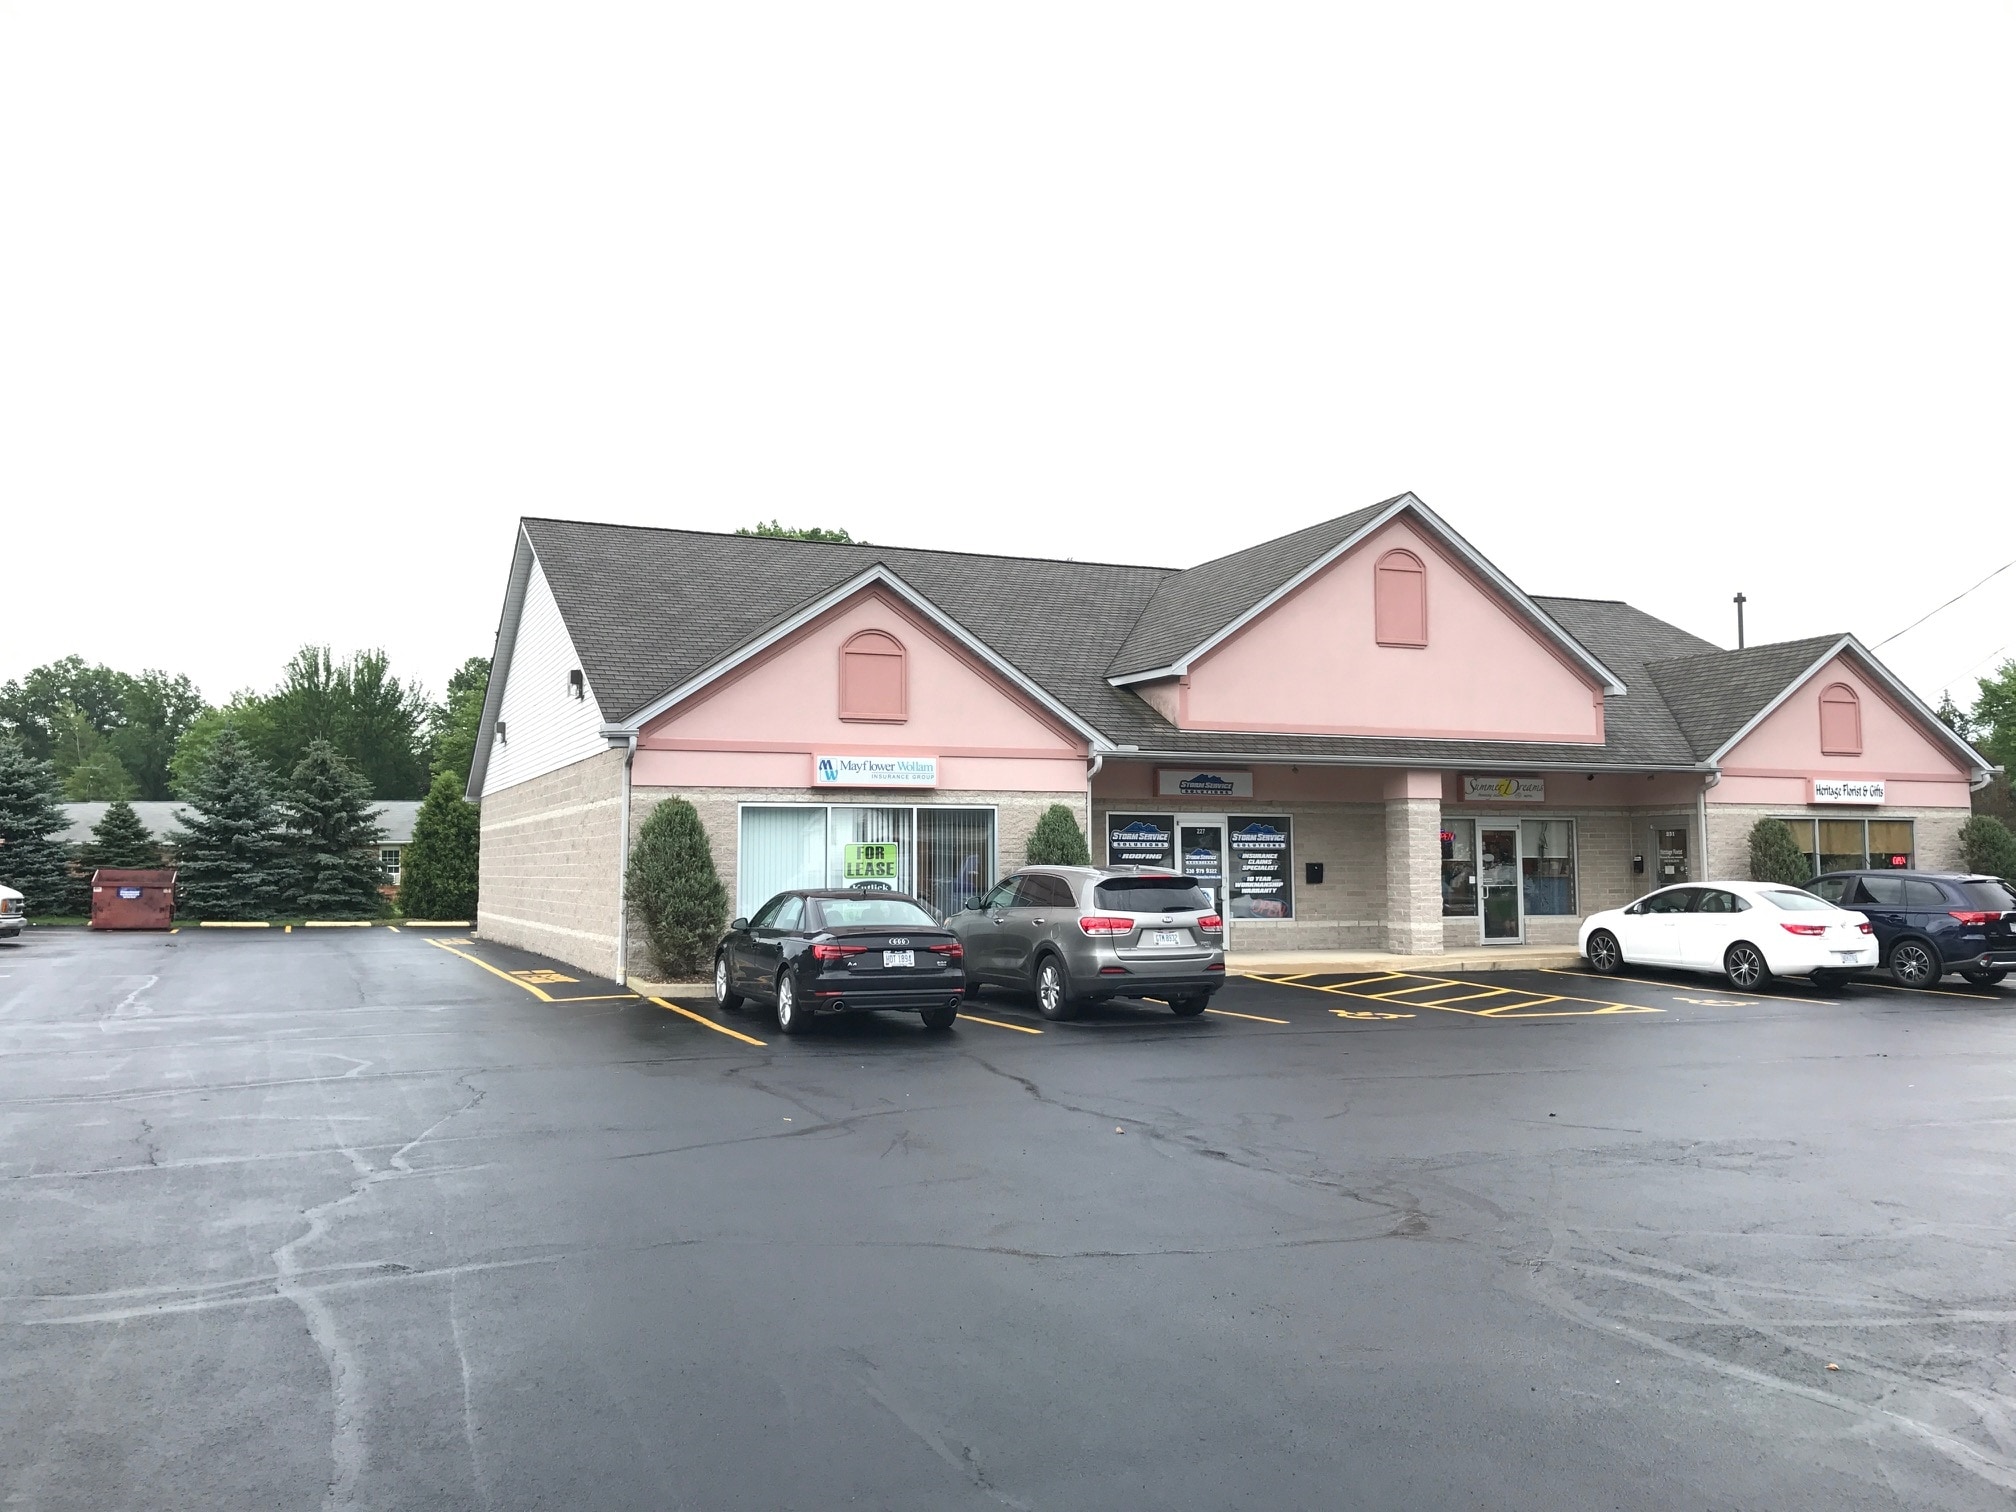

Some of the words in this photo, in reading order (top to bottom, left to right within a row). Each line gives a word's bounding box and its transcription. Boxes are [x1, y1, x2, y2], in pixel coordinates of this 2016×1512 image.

[840, 760, 895, 774] Mayflower
[897, 761, 934, 772] Wollam
[1464, 776, 1504, 795] Summer
[1502, 779, 1544, 796] Dreams
[1815, 784, 1842, 800] Heritage
[1843, 784, 1862, 797] Florist
[1862, 785, 1868, 797] &
[1869, 784, 1884, 798] Gifts
[1112, 832, 1139, 841] STORM
[1138, 832, 1169, 841] SERVICE
[1232, 833, 1258, 842] STORM
[1257, 833, 1285, 842] SERVICE
[856, 846, 885, 860] FOR
[846, 862, 895, 876] LEASE
[1241, 887, 1277, 895] WARRANTY
